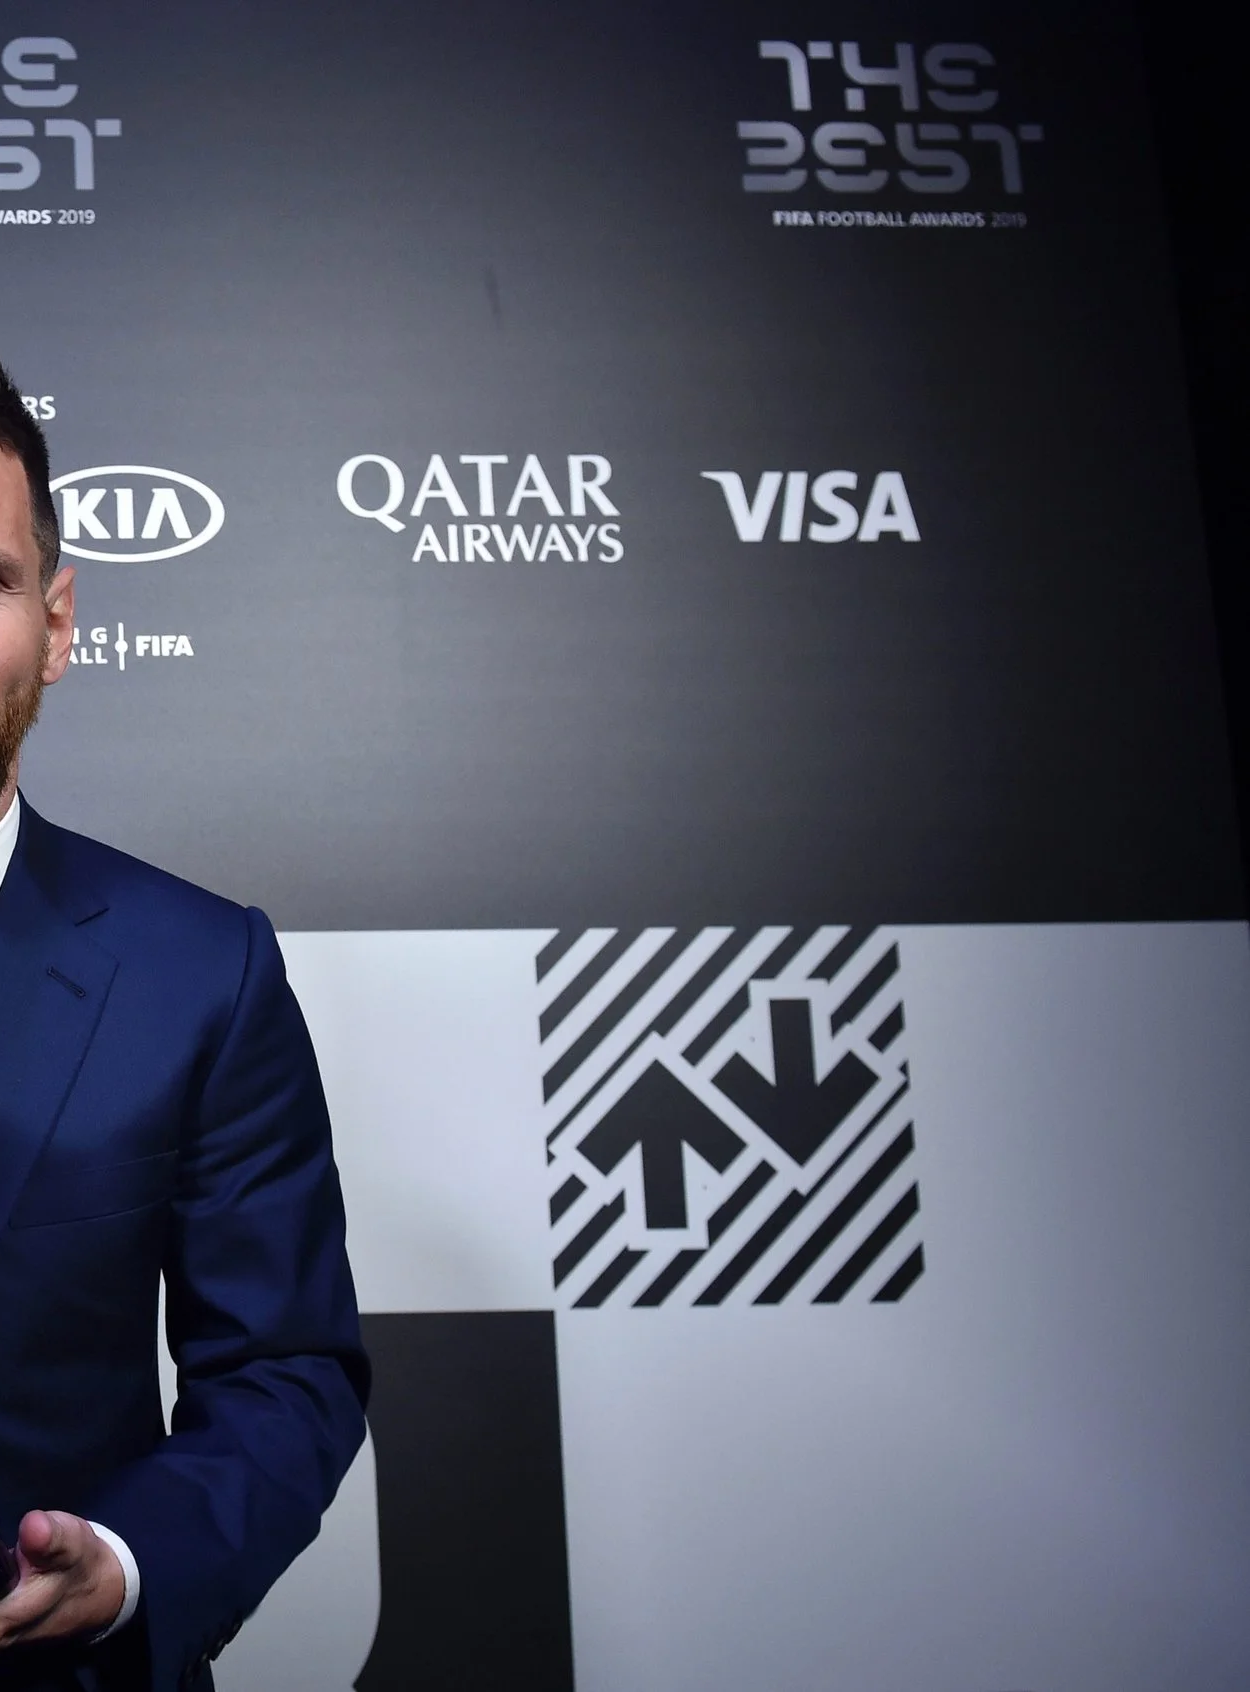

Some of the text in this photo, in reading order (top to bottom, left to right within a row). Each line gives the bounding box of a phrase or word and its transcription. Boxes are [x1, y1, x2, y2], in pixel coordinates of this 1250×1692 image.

[758, 40, 1000, 112] THE
[737, 121, 1045, 194] BEST
[57, 209, 96, 225] 2019
[772, 210, 1028, 228] FIFA FOOTBALL AWARDS 2019
[60, 488, 193, 540] KIA
[336, 453, 621, 533] QATAR
[700, 470, 921, 543] VISA
[411, 523, 624, 563] AIRWAYS
[135, 635, 195, 657] FIFA
